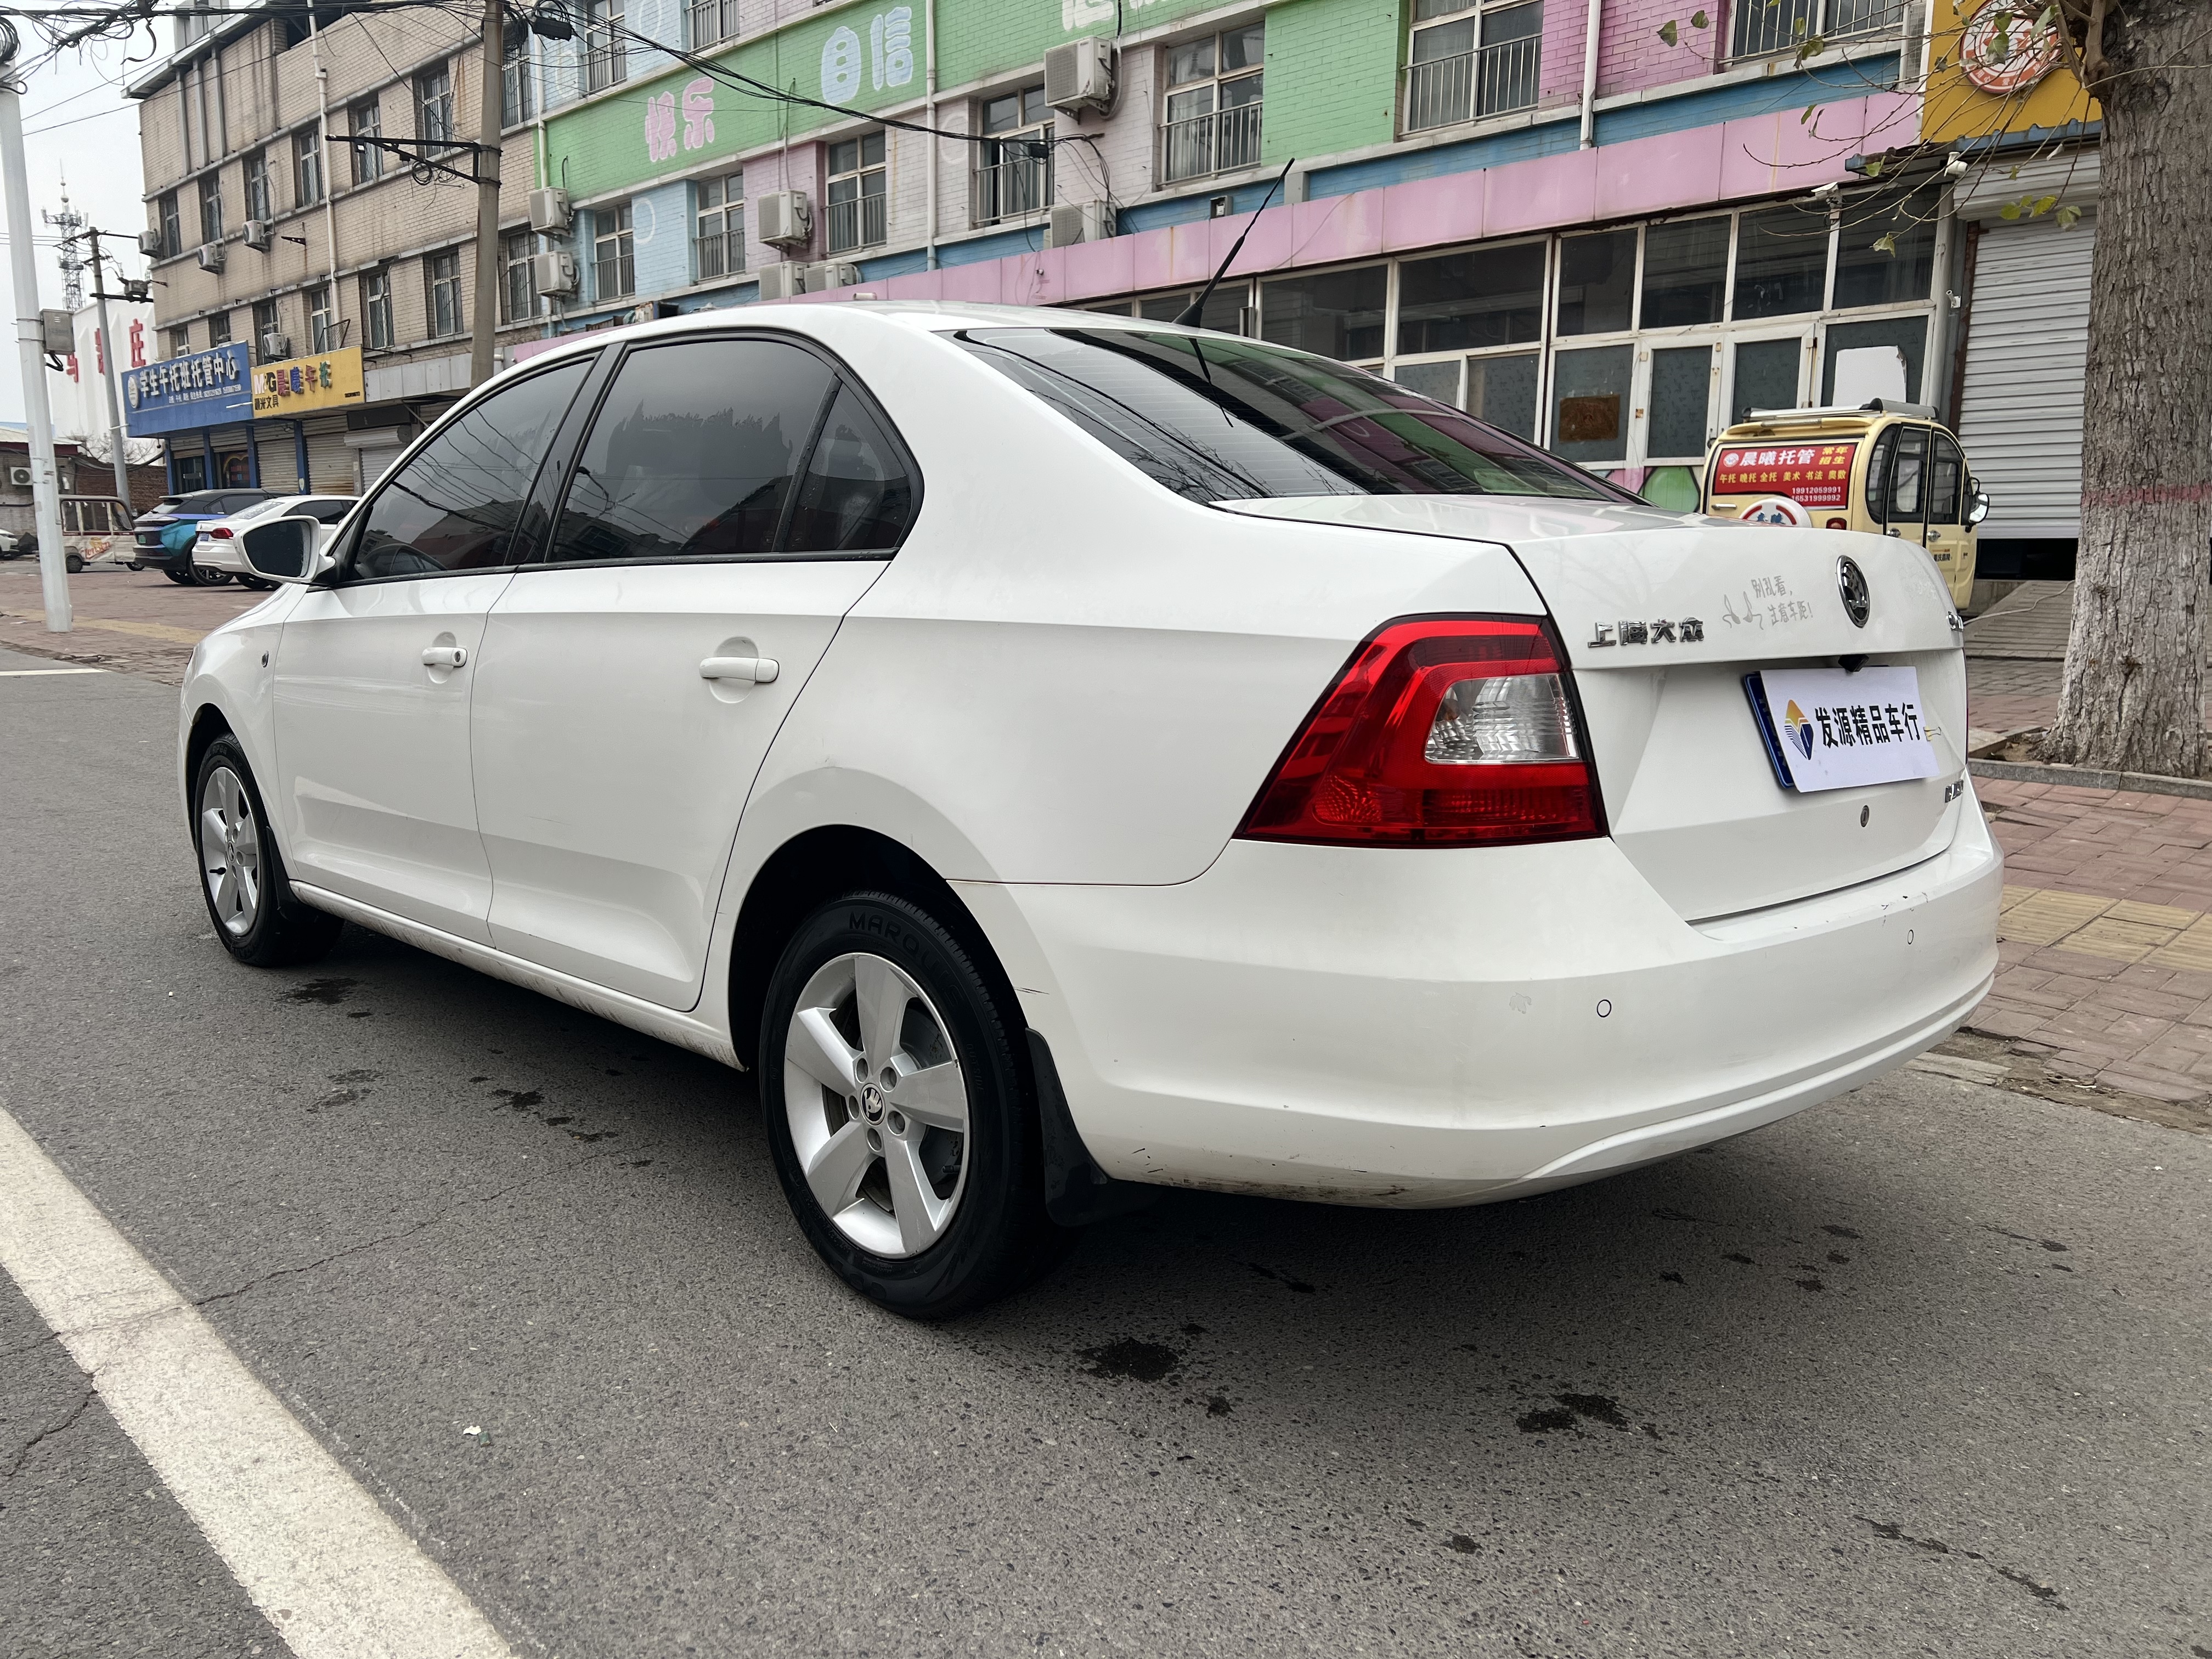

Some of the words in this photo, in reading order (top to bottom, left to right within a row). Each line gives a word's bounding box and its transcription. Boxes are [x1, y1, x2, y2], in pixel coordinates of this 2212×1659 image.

[645, 76, 715, 162] 快乐
[821, 5, 913, 104] 自信
[139, 349, 240, 398] 学生午托班托管中心
[1739, 449, 1815, 466] 晨曦托管
[1819, 456, 1846, 465] 招生
[1822, 446, 1849, 455] 常年
[1719, 473, 1736, 484] 午托
[1740, 472, 1757, 483] 晚托
[1760, 471, 1778, 482] 全托
[1783, 471, 1801, 482] 美术
[1805, 470, 1824, 481] 书法
[1828, 470, 1847, 480] 奥数
[1792, 486, 1842, 494] 19912059991
[1587, 616, 1705, 648] 上海大众
[1814, 702, 1921, 749] 发源精品车行
[848, 910, 964, 1006] MARQUIS
